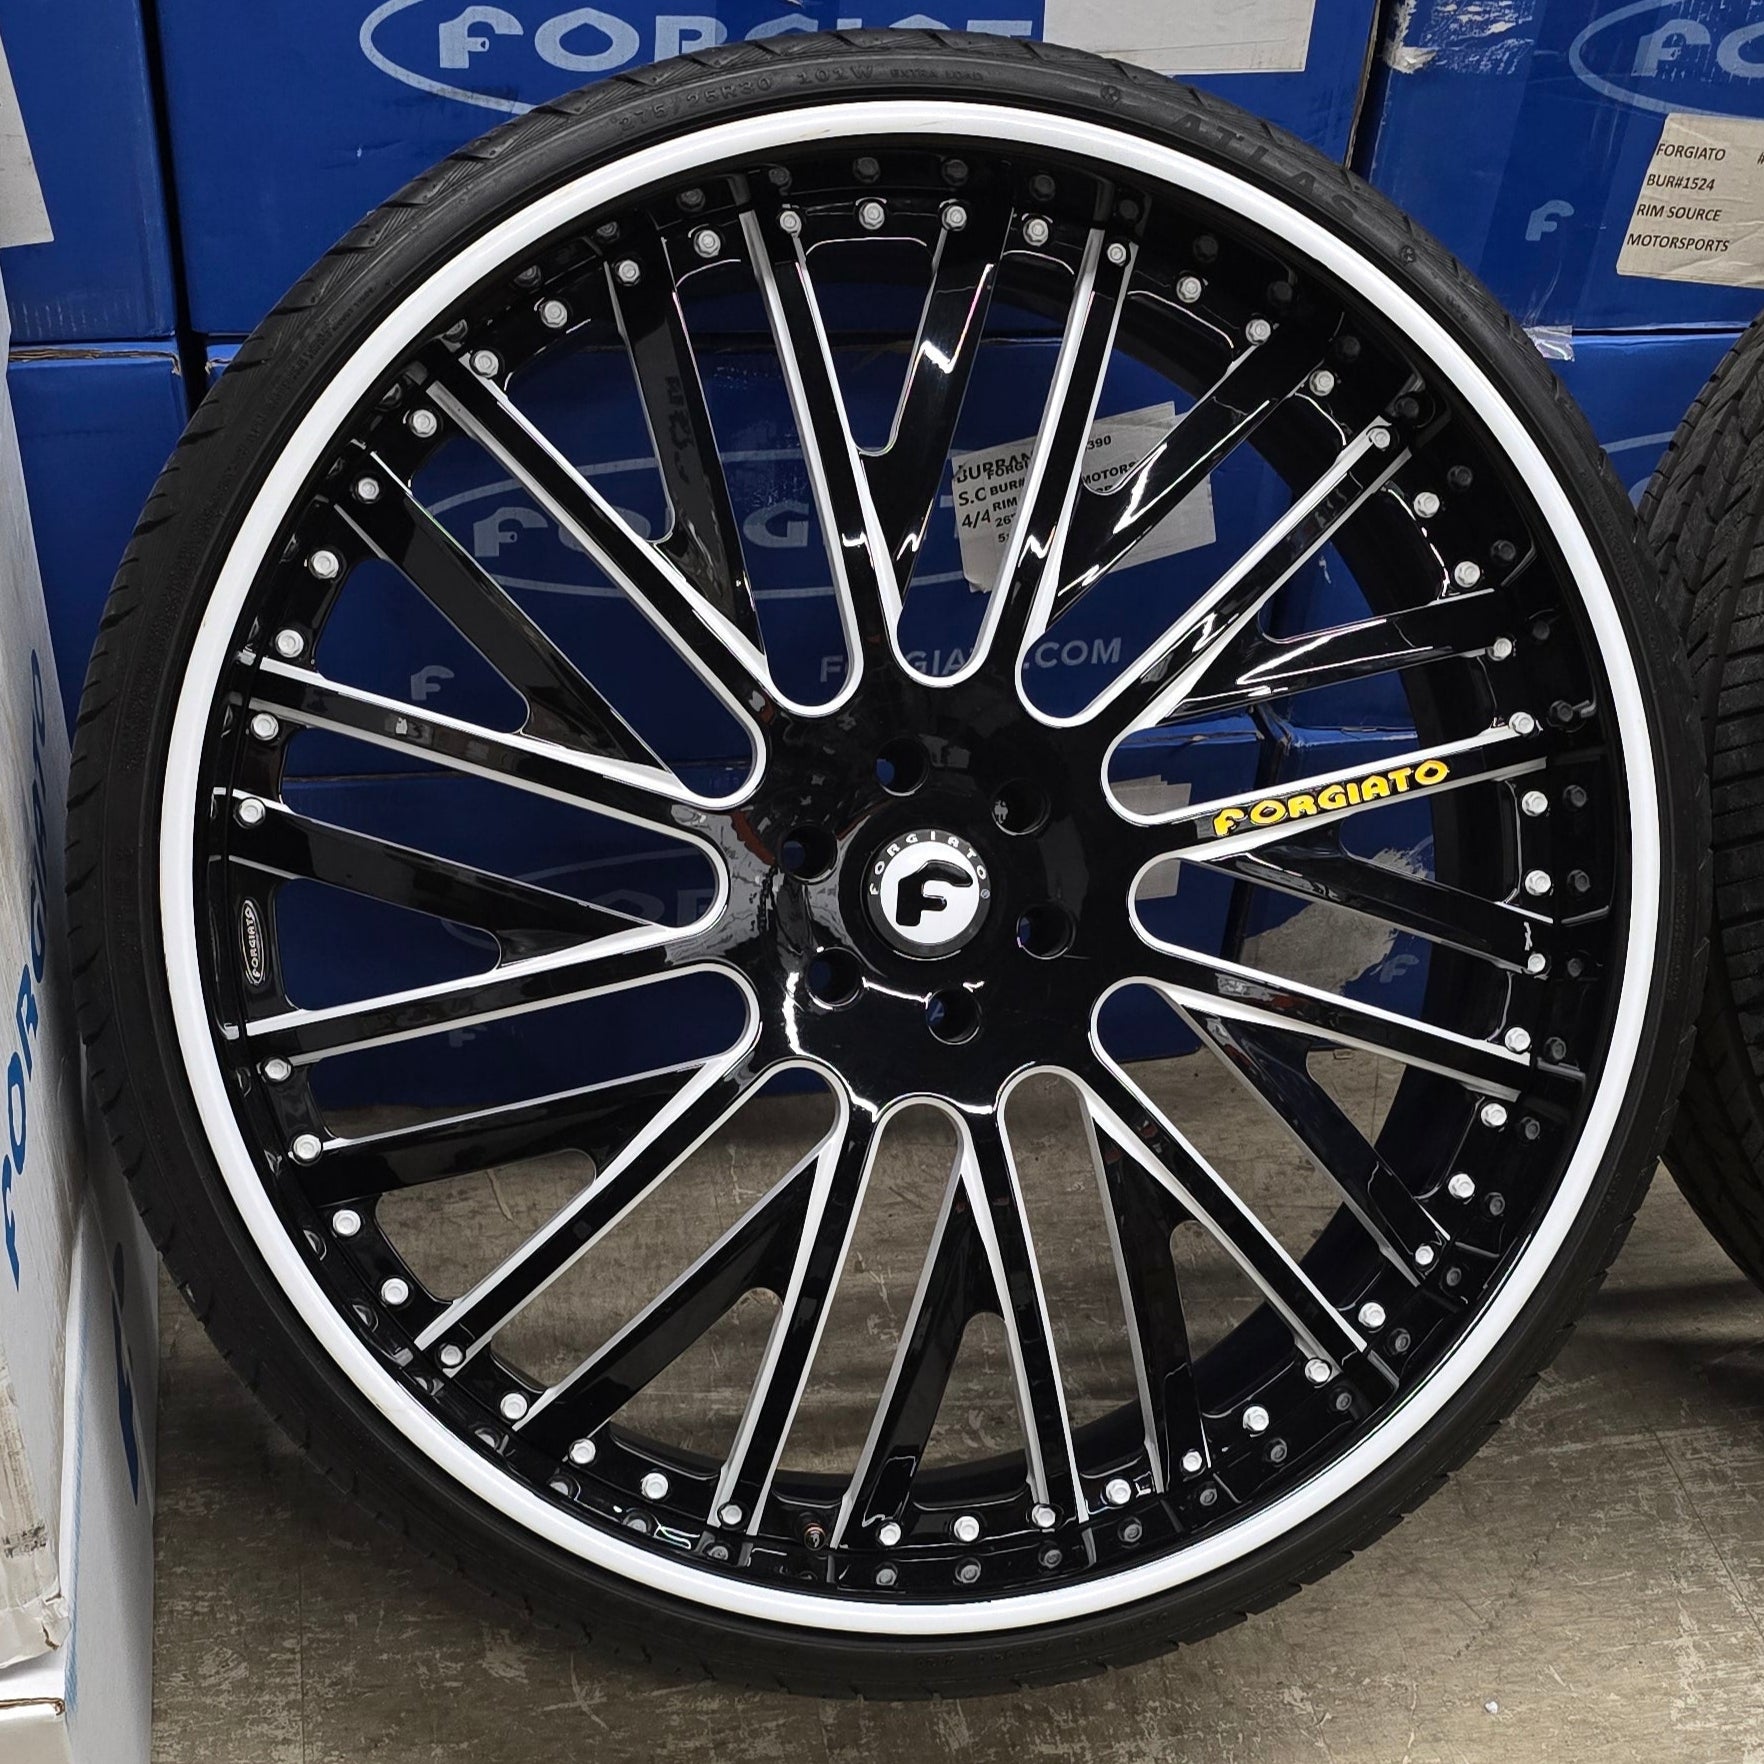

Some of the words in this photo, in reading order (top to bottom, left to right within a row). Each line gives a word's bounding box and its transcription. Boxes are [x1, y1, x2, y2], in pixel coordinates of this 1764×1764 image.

[1655, 143, 1727, 162] FORGIATO
[1166, 112, 1360, 216] ATLAS
[1646, 173, 1716, 192] BUR#1524
[1637, 203, 1664, 219] RIM
[1666, 205, 1722, 222] SOURCE
[1626, 232, 1730, 253] MOTORSPORTS
[1086, 434, 1112, 450] 390
[992, 496, 1019, 512] RIM
[1212, 758, 1451, 837] FORGIATO
[868, 830, 988, 896] FORGIATO
[244, 906, 261, 979] FORGIATO
[0, 648, 48, 1292] FORGIATO
